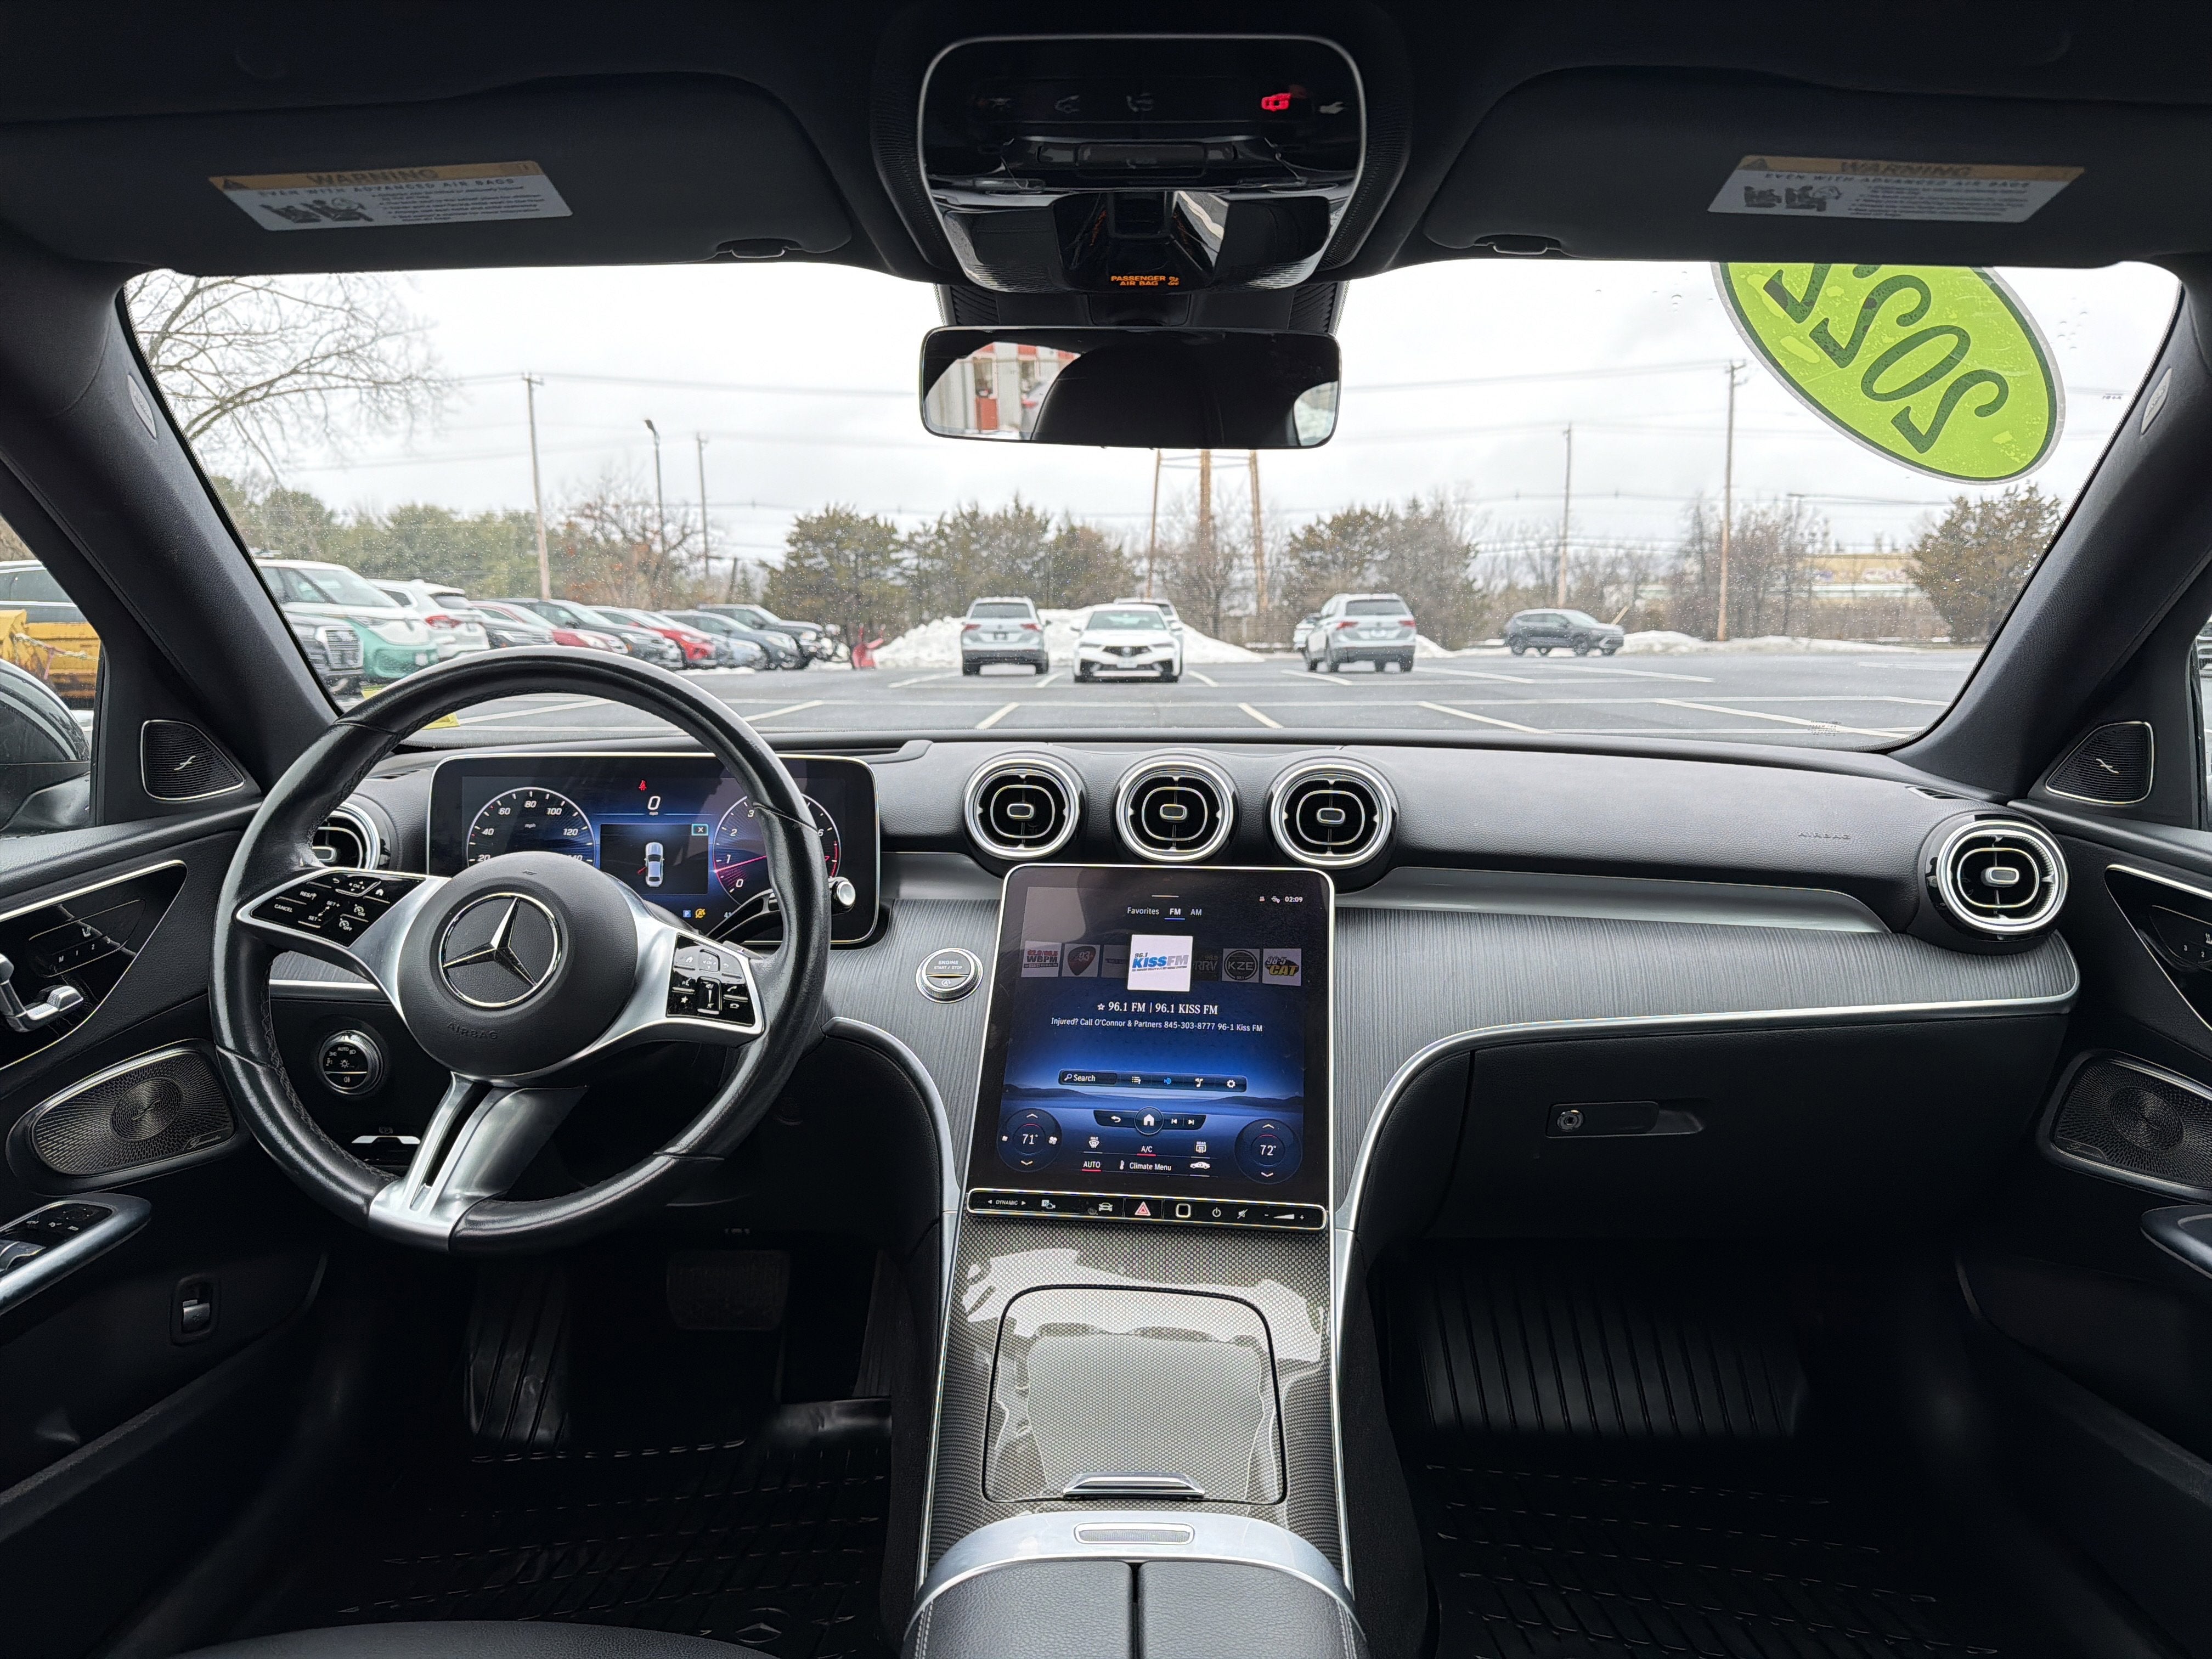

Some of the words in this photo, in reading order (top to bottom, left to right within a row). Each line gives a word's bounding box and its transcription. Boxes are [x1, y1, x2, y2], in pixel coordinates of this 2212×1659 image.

[1841, 161, 1971, 177] WARNING
[307, 168, 438, 185] WARNING
[647, 796, 661, 810] 0
[747, 809, 755, 817] 3
[730, 828, 738, 837] 2
[725, 854, 731, 864] 1
[736, 879, 744, 887] 0
[274, 904, 293, 913] CANCEL
[1127, 906, 1160, 915] Favorites
[1228, 961, 1254, 970] KZE
[1269, 965, 1299, 975] CAT
[1108, 1001, 1127, 1012] 96.1
[1131, 1002, 1146, 1012] FM
[1155, 1003, 1175, 1013] 96.1
[1178, 1004, 1201, 1014] KISS
[1203, 1005, 1218, 1015] FM
[1051, 1017, 1079, 1026] Injured?
[1094, 1018, 1126, 1027] O'Connor
[1134, 1020, 1163, 1028] Partners
[1164, 1021, 1216, 1030] 845-303-8777
[1217, 1023, 1234, 1031] 96-1
[447, 1021, 498, 1040] AIRBAG
[1073, 1074, 1096, 1082] Search
[1022, 1133, 1039, 1145] 71°
[1260, 1144, 1277, 1156] 72°
[1129, 1162, 1153, 1170] Climate
[1154, 1163, 1172, 1171] Menu
